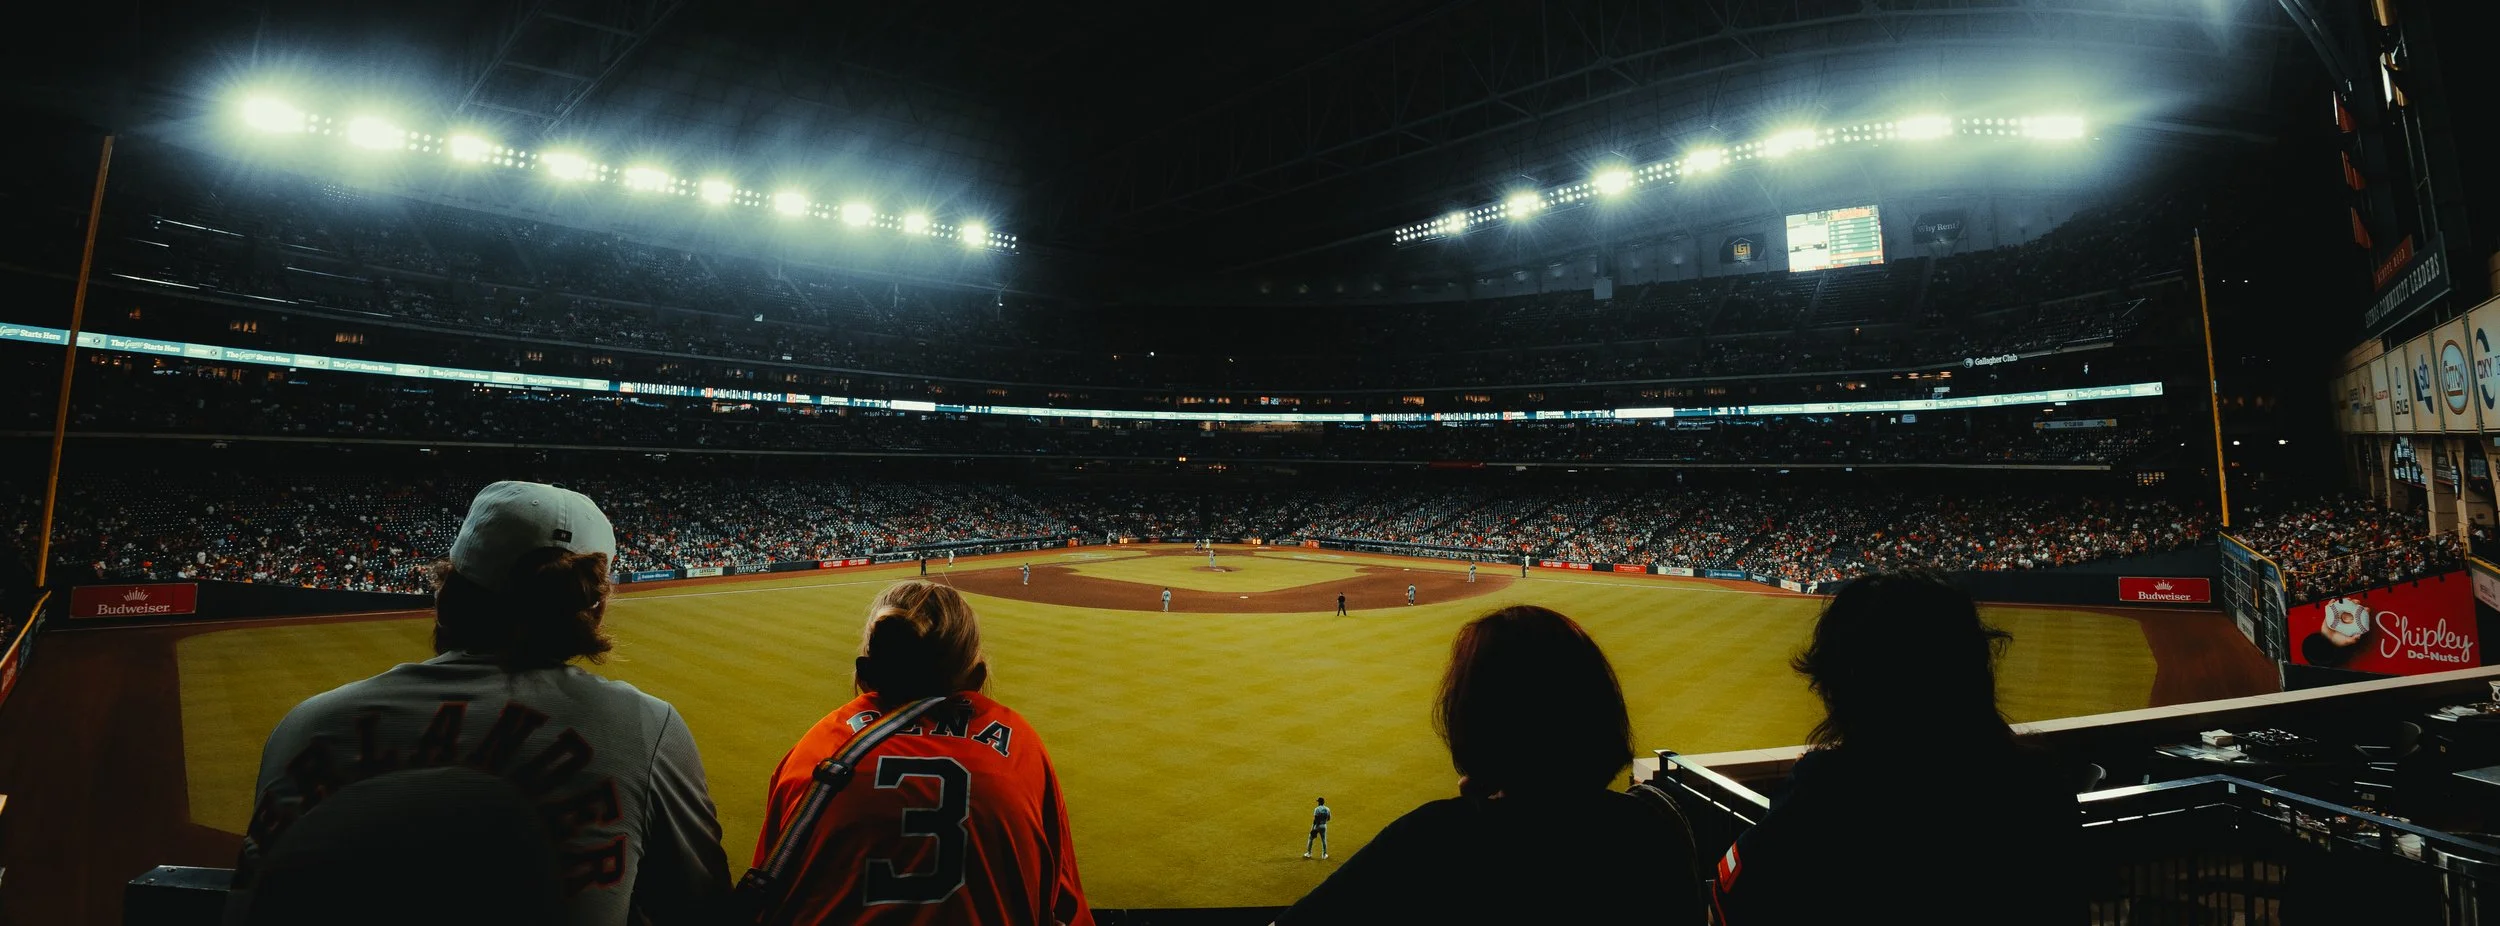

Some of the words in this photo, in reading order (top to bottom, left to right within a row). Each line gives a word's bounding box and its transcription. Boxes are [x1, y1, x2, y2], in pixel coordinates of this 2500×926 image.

[2409, 252, 2440, 294] LEADERS
[20, 329, 43, 338] Starts
[43, 332, 60, 341] Here
[144, 342, 163, 351] Starts
[164, 345, 181, 353] Here
[2003, 353, 2018, 362] Club
[2137, 591, 2191, 601] Budweiser
[97, 603, 170, 615] Budweiser
[2375, 610, 2474, 663] Shipley
[2407, 649, 2461, 663] Do-Nuts
[862, 755, 972, 907] 3
